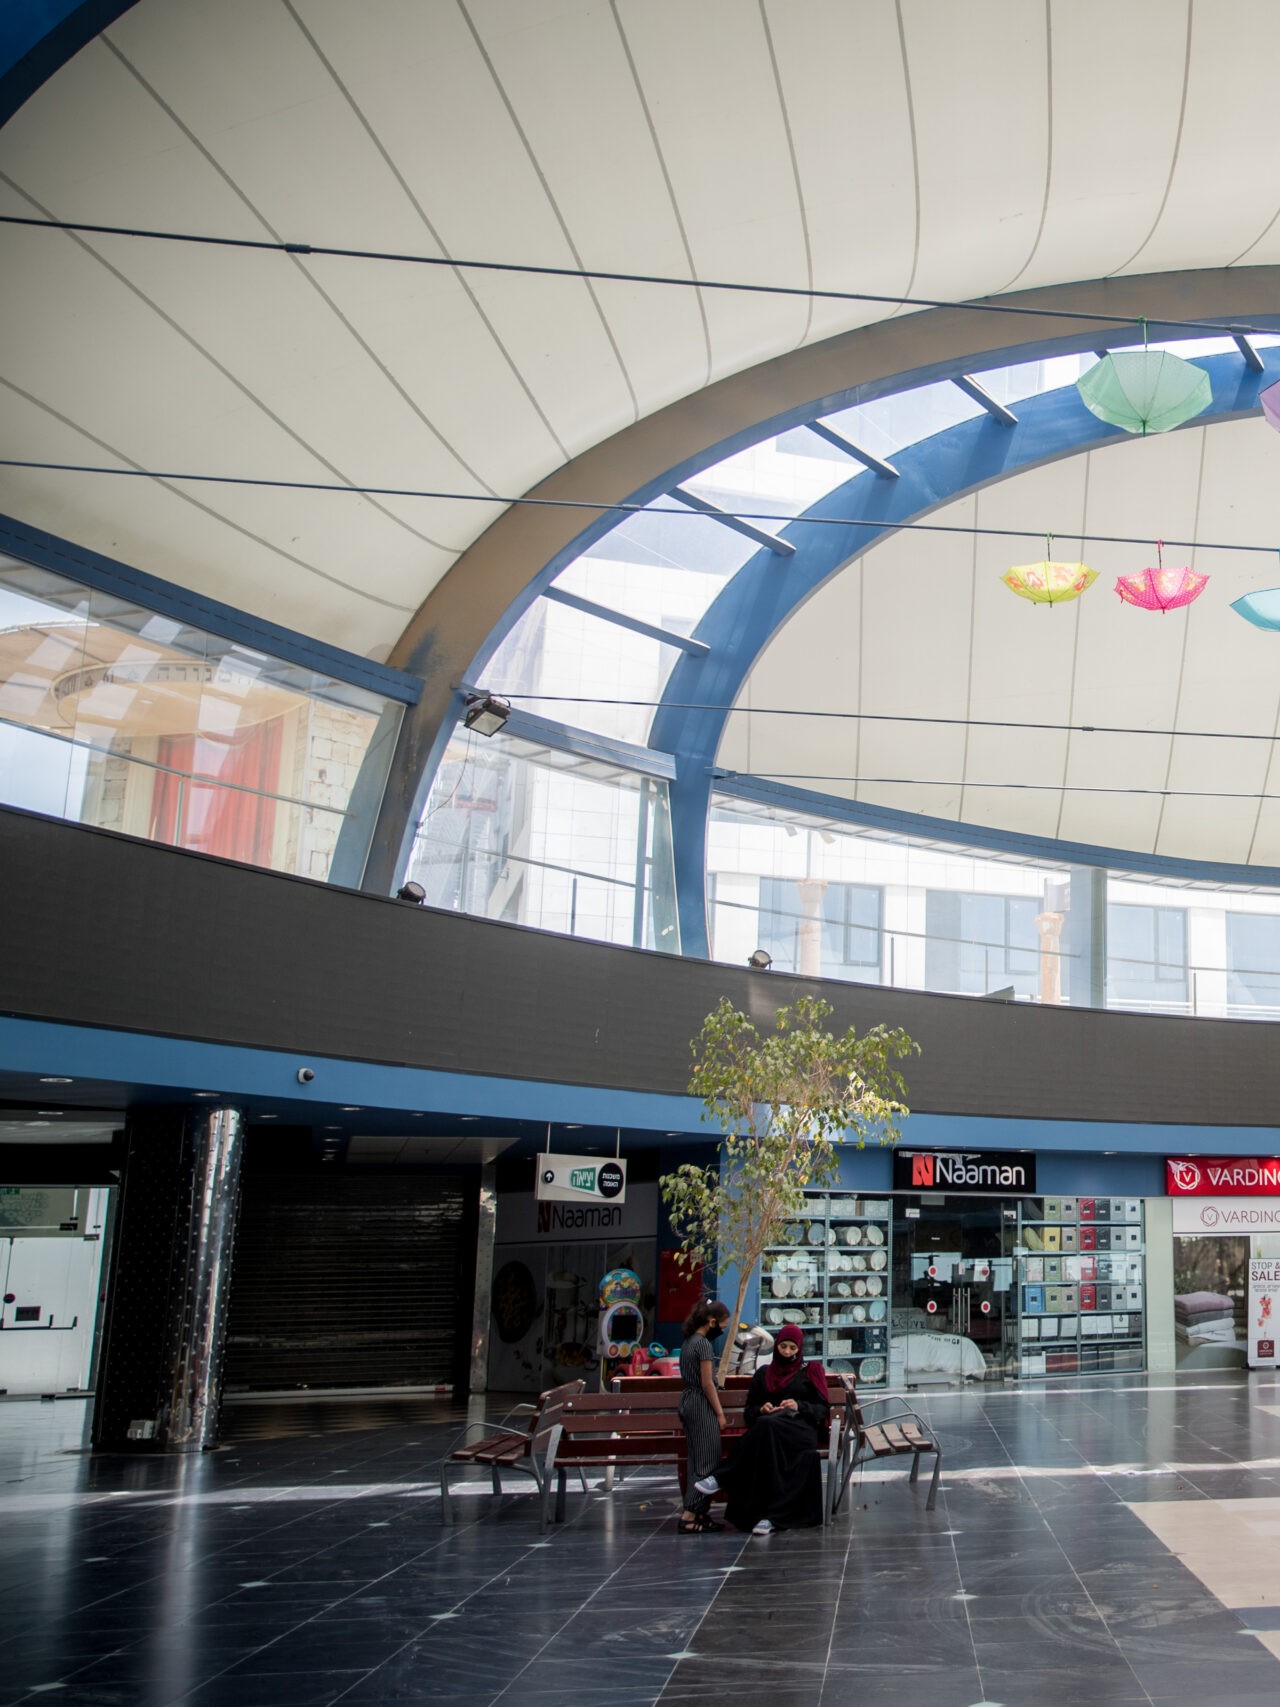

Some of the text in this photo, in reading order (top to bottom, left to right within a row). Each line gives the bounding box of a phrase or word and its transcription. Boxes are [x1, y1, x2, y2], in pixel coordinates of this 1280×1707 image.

[573, 1171, 594, 1186] יציאה
[936, 1158, 1025, 1185] Naaman
[552, 1205, 622, 1229] Naaman
[1251, 1261, 1272, 1270] STOP
[1251, 1270, 1280, 1281] SALE
